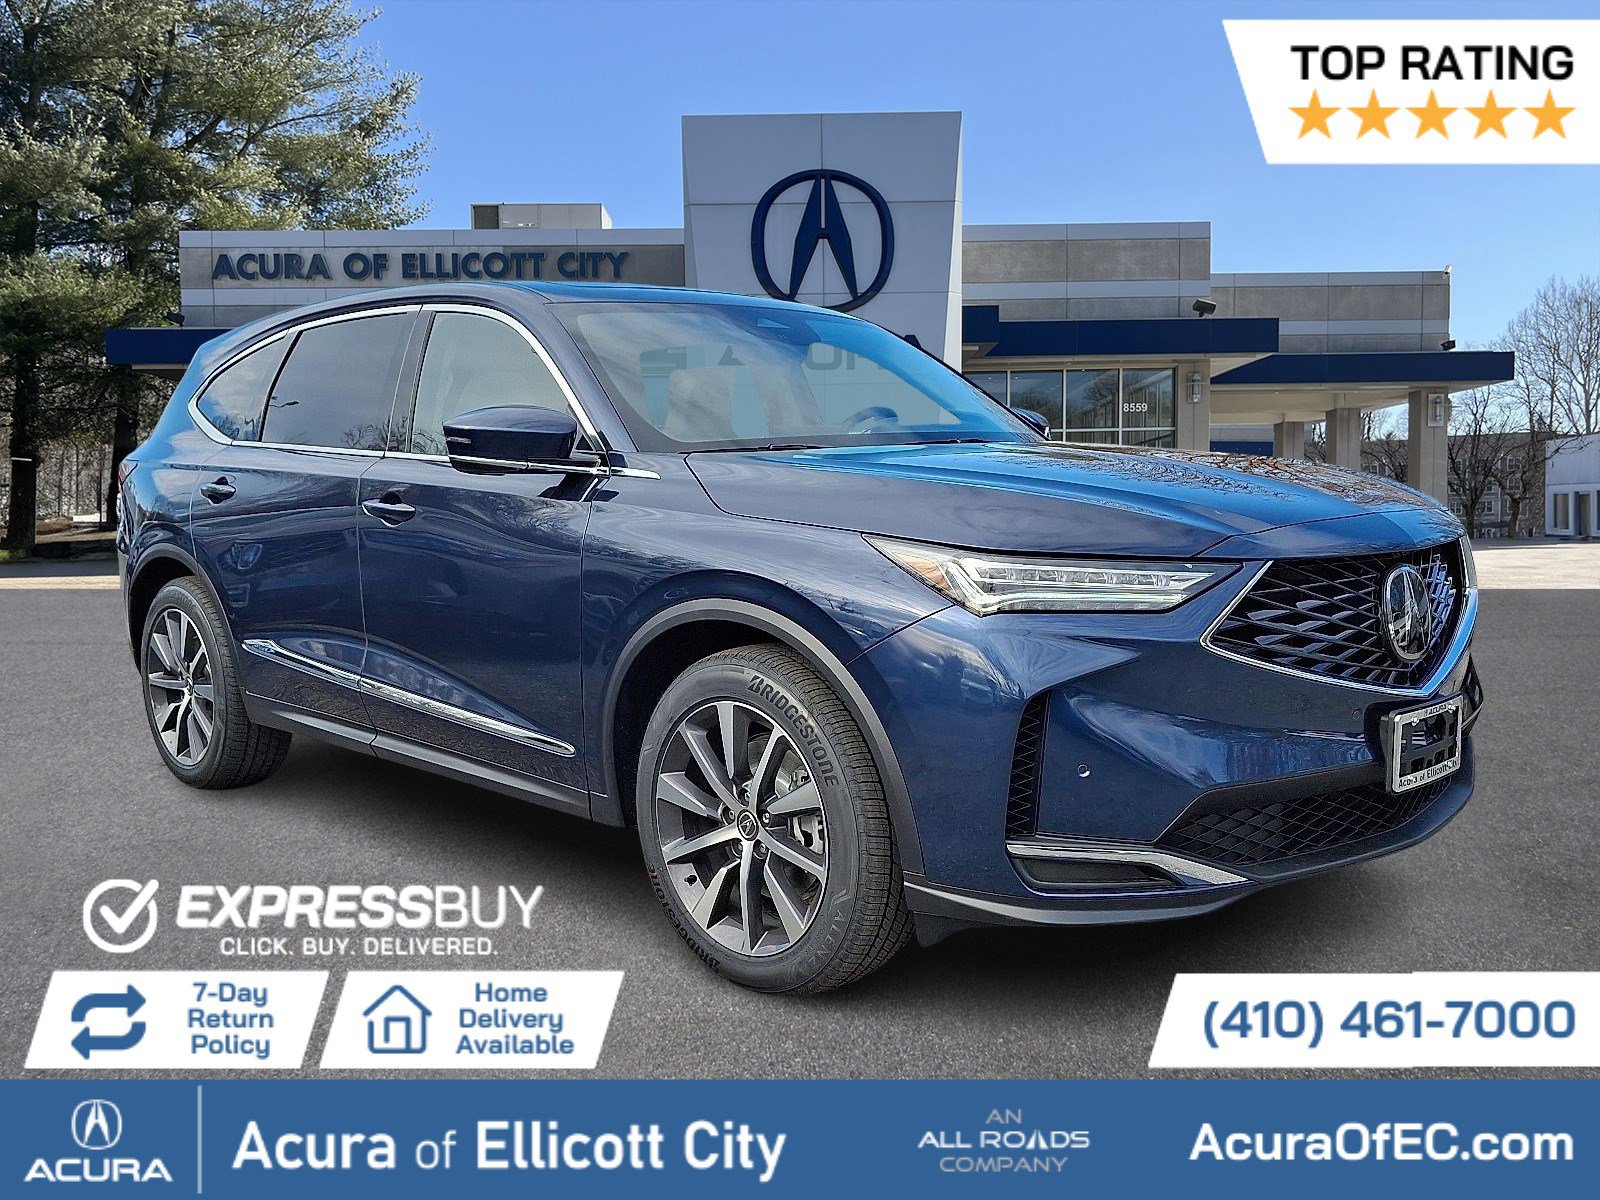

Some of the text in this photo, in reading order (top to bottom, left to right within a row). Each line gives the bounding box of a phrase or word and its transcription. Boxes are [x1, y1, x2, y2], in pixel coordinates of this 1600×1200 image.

[212, 252, 630, 281] ACURA OF ELLICOTT CITY
[1123, 403, 1148, 412] 8559
[747, 674, 839, 787] BRIDGESTONE
[1399, 776, 1418, 788] Acua
[1420, 773, 1426, 782] of
